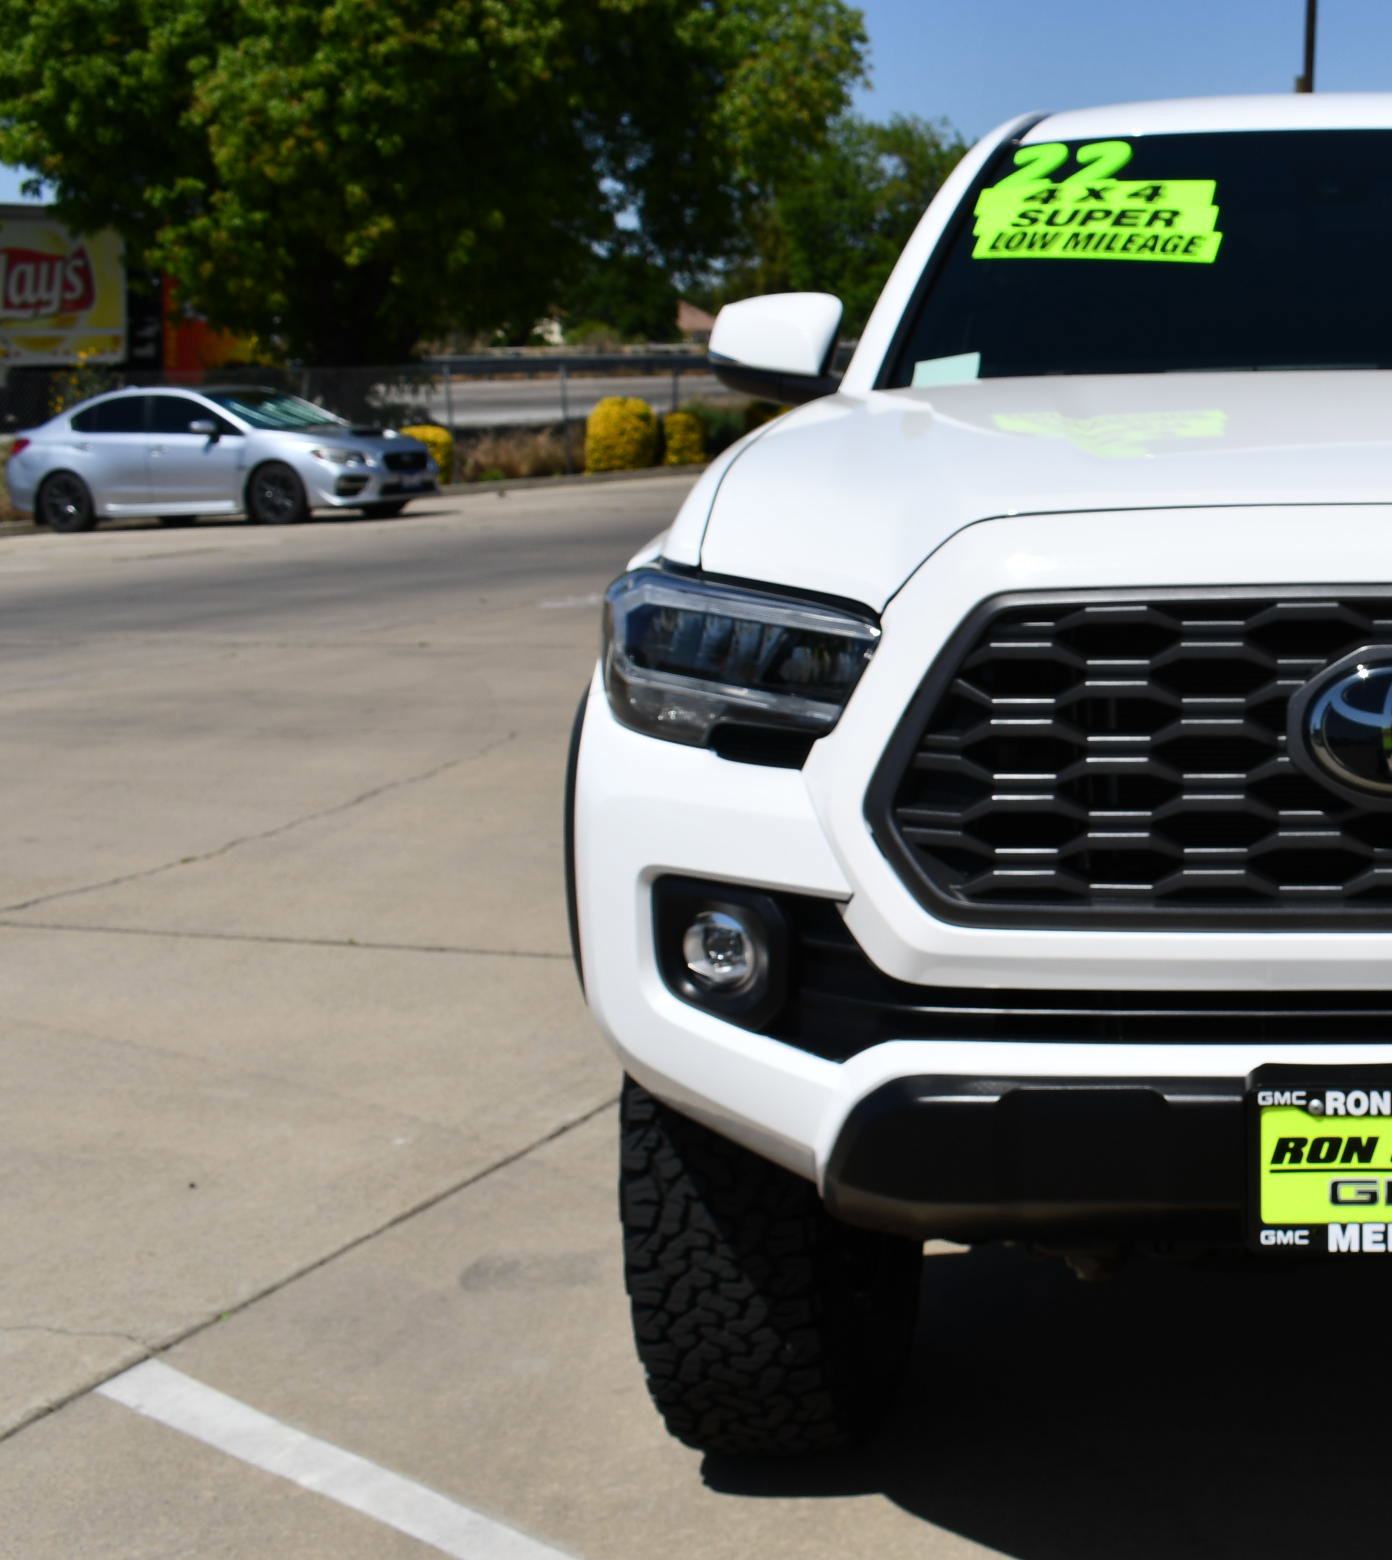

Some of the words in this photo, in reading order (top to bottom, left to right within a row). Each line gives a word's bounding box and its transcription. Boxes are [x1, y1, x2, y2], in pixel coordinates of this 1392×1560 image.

[994, 141, 1132, 187] 22
[1011, 209, 1181, 227] SUPER
[990, 232, 1058, 250] LOW
[1062, 232, 1207, 254] MILEAGE
[1257, 1091, 1307, 1106] GMC
[1325, 1090, 1392, 1116] RON
[1270, 1136, 1380, 1165] RON
[1260, 1229, 1310, 1245] GMC
